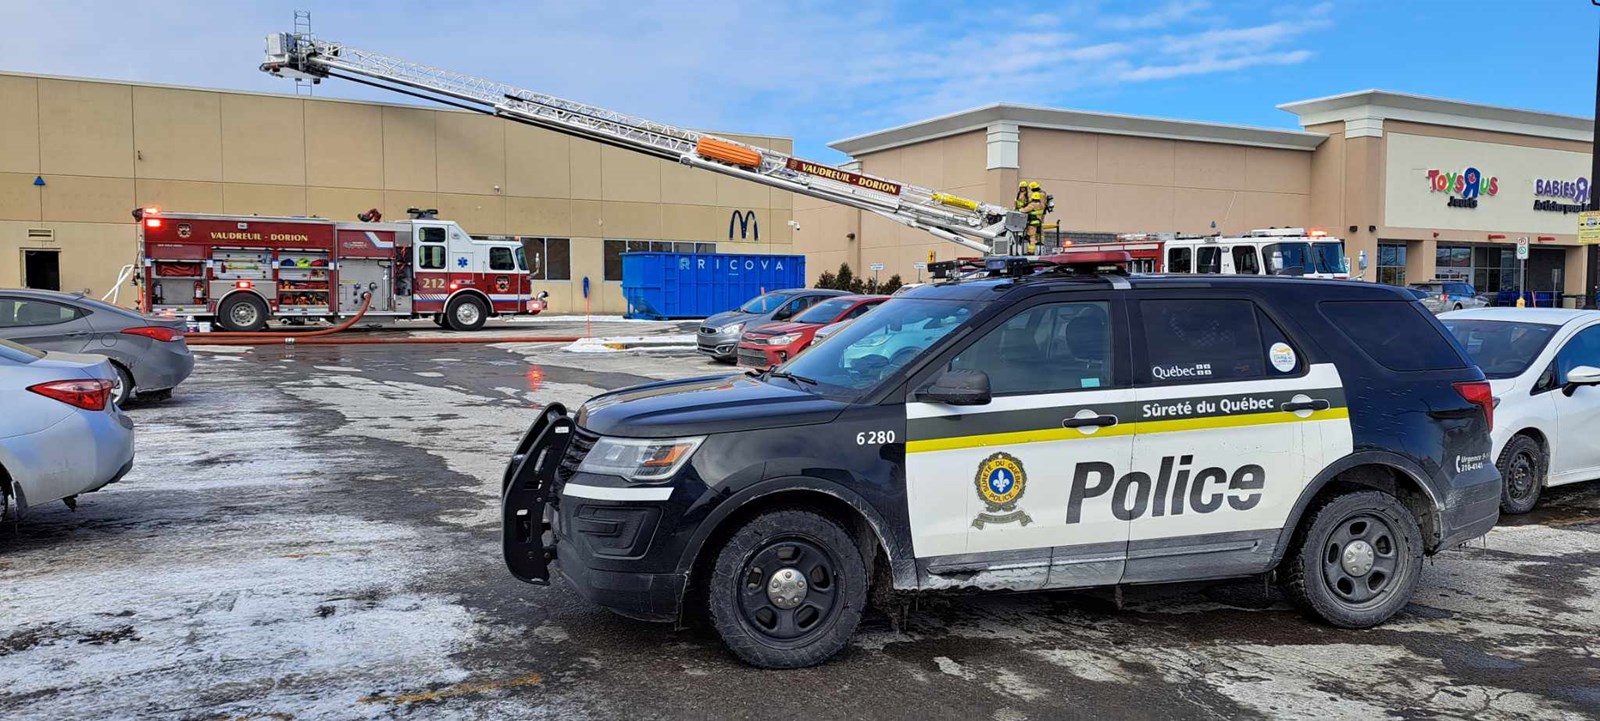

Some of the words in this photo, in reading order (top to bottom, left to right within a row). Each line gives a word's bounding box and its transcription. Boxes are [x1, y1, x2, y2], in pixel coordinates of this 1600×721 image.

[802, 163, 850, 182] VAUDREUIL
[858, 177, 897, 193] DORION
[211, 232, 261, 240] VAUDREUIL
[698, 259, 784, 271] RICOVA
[423, 278, 445, 288] 212
[1152, 366, 1196, 379] Québec
[1142, 401, 1192, 418] Sûreté
[1196, 401, 1216, 413] du
[1220, 397, 1274, 413] Québec
[1066, 454, 1266, 525] Police
[988, 492, 1014, 502] POLICE
